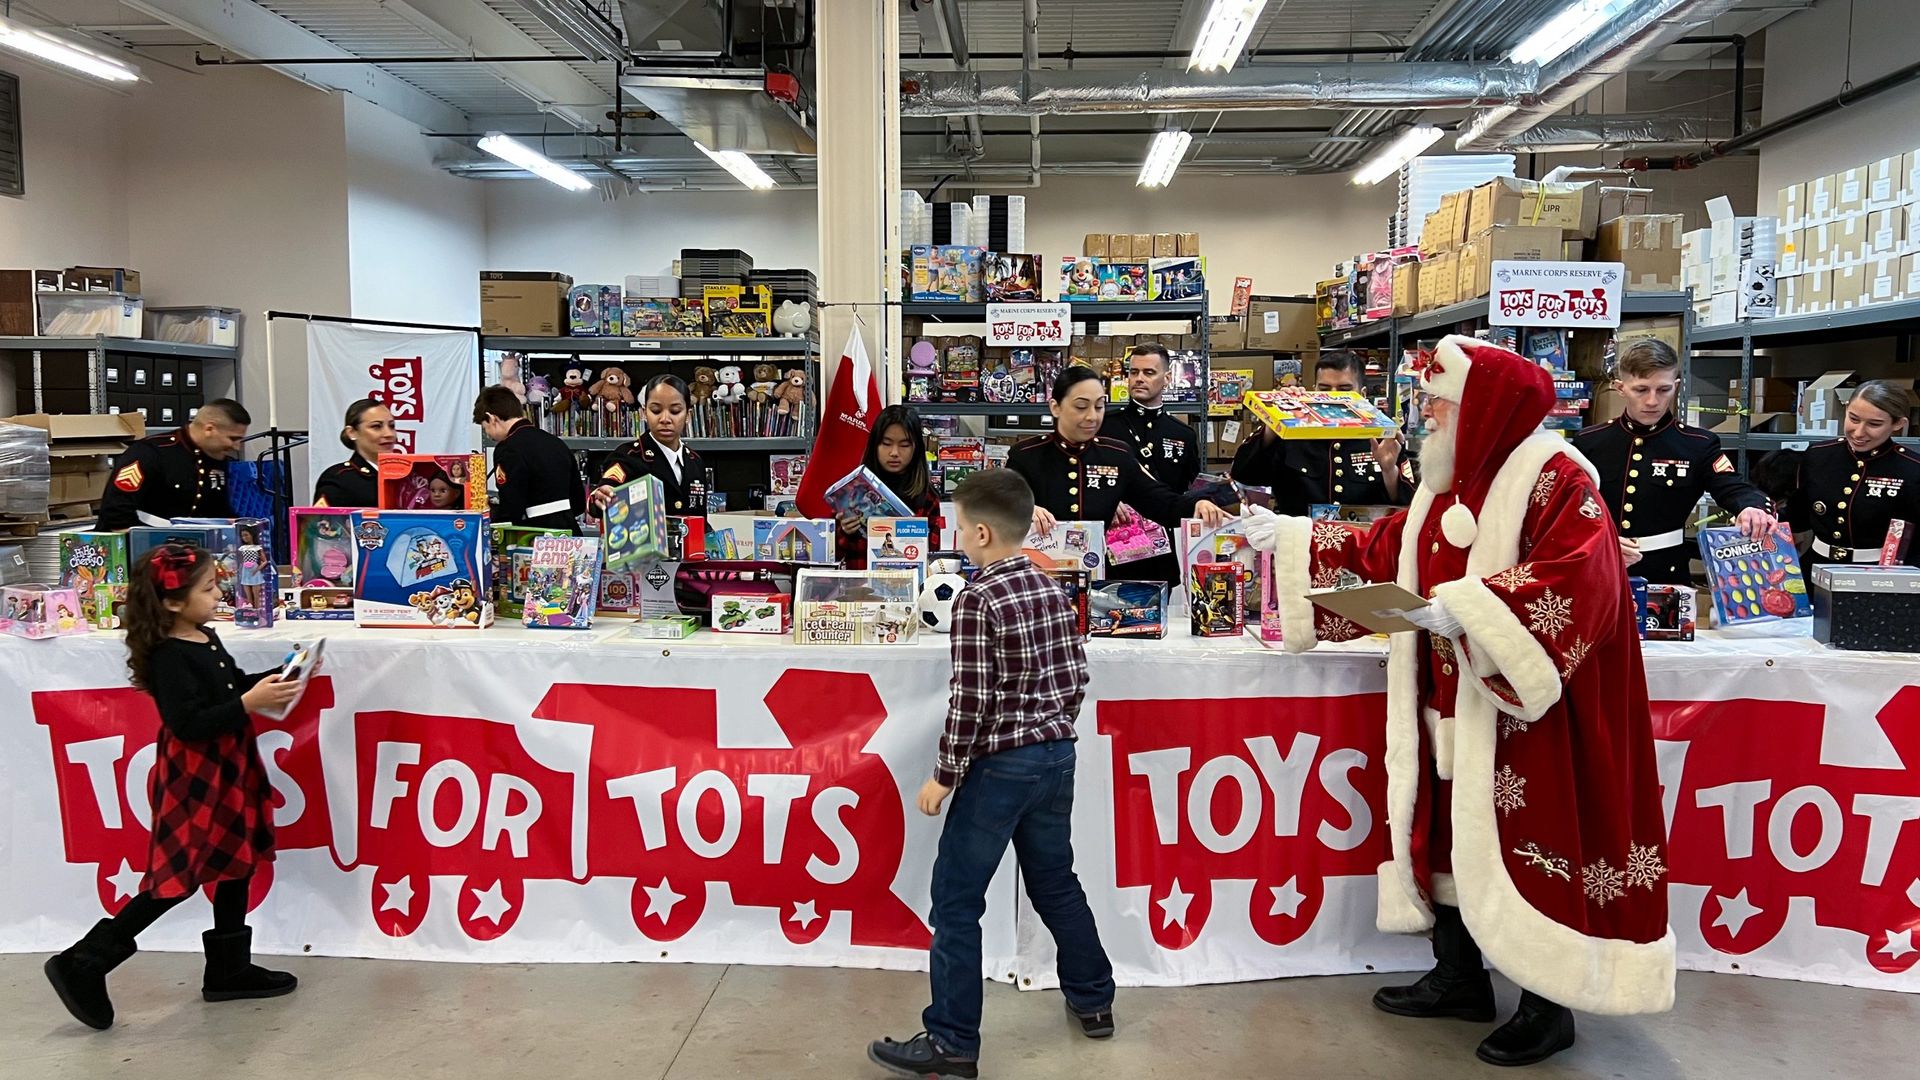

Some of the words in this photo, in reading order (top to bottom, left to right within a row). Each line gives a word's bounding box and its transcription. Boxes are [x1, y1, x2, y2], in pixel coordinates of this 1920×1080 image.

[1512, 269, 1540, 277] MARINE
[1543, 269, 1568, 277] CORPS
[1569, 270, 1602, 278] RESERVE
[1501, 291, 1532, 307] TOYS
[1538, 295, 1564, 310] FOR
[1571, 298, 1604, 313] TOTS
[994, 322, 1014, 335] TOYS
[1018, 326, 1034, 336] FOR
[1038, 326, 1060, 338] TOTS
[388, 362, 417, 417] TOYS
[535, 537, 584, 552] CANDY
[905, 547, 917, 555] 42
[1715, 541, 1763, 559] CONNECT
[1762, 533, 1777, 553] 4
[533, 551, 569, 565] LAND
[608, 585, 626, 594] 100
[1235, 582, 1243, 625] TRANSFORMERS
[808, 629, 850, 641] Counter
[65, 730, 306, 832] TS
[1128, 731, 1369, 854] TOYS
[370, 741, 542, 859] FOR
[606, 766, 860, 885] TOTS
[1696, 778, 1920, 907] TOT
